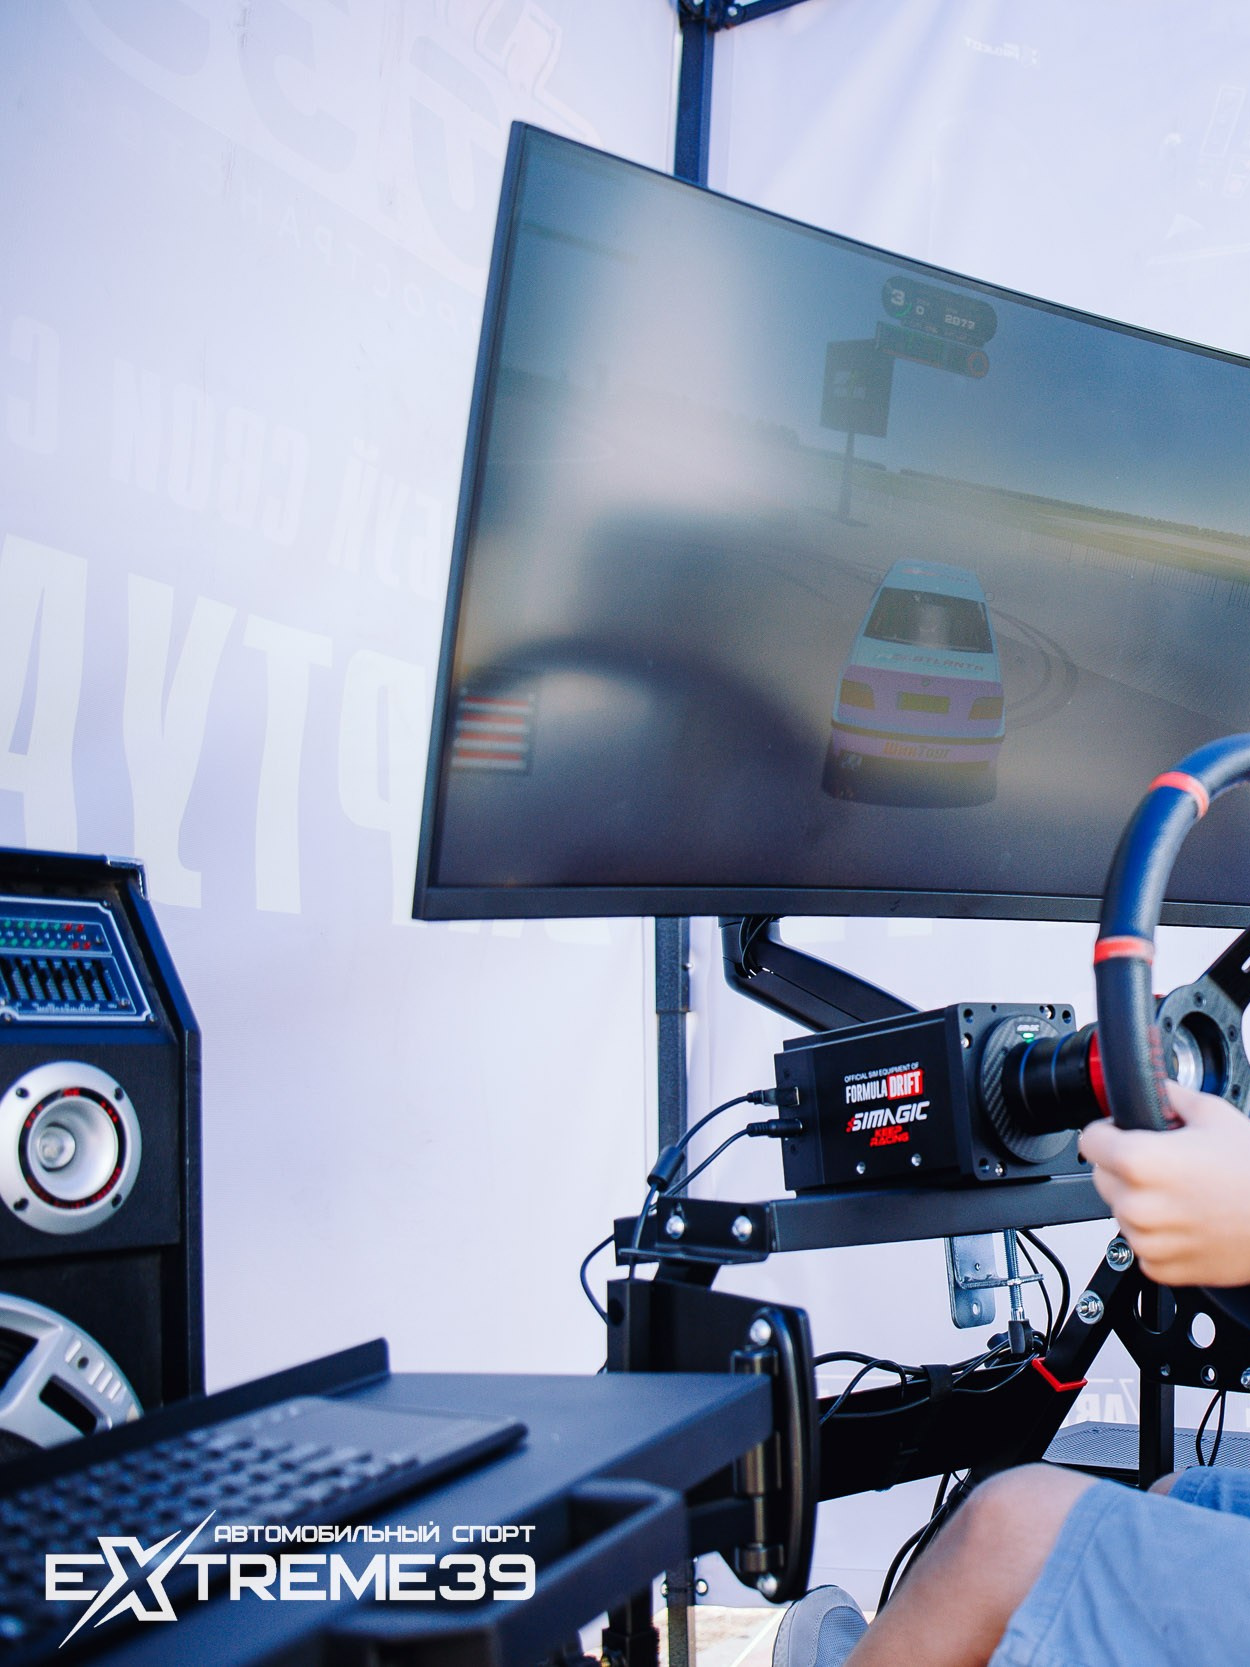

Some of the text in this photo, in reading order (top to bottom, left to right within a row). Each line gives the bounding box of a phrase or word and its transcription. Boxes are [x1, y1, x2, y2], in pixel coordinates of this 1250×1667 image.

[844, 1072, 868, 1083] OFFICIAL
[878, 1063, 911, 1077] EQUIPMENT
[845, 1071, 921, 1104] FORMULA DRIFT
[851, 1100, 930, 1132] SIMAGIC
